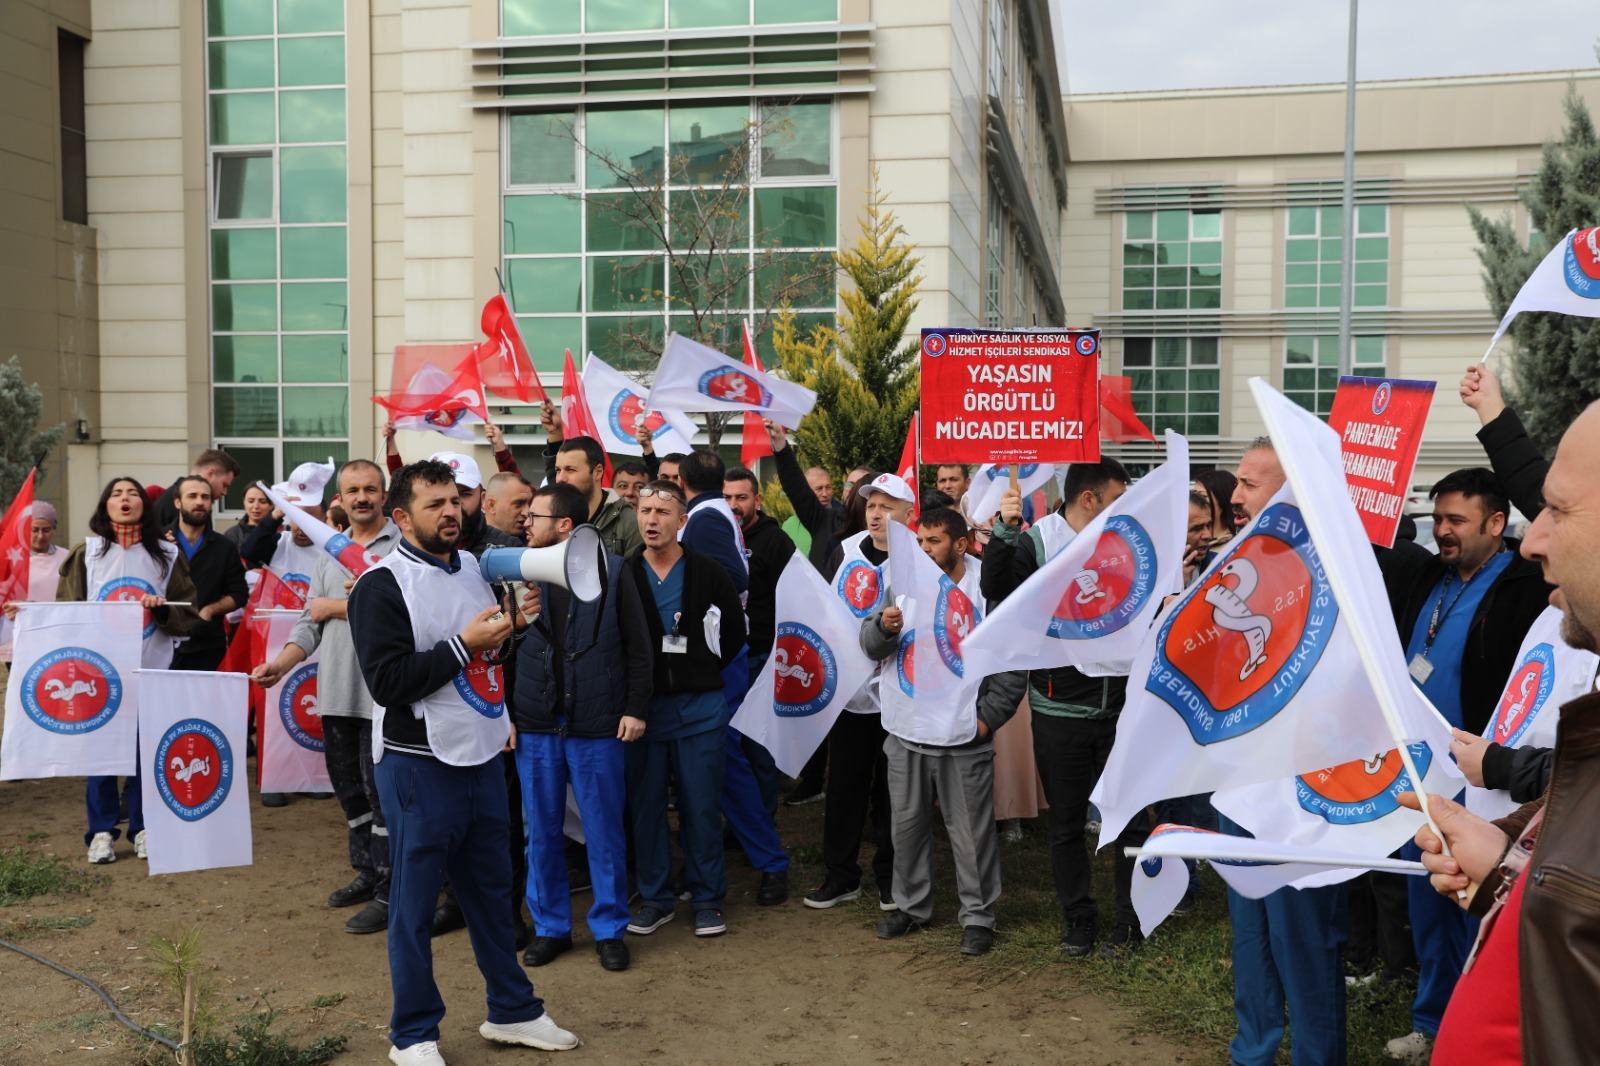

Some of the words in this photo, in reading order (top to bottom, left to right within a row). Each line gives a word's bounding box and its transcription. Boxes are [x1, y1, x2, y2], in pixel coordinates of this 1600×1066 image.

[949, 333, 988, 344] TÜRKİYE
[989, 333, 1021, 343] SAĞLIK
[1024, 335, 1035, 343] VE
[1036, 335, 1071, 343] SOSYAL
[949, 345, 982, 356] HİZMET
[985, 345, 1022, 359] İŞÇİLERİ
[1024, 345, 1070, 356] SENDİKASI
[967, 364, 1052, 387] YAŞASIN
[963, 388, 1055, 411] ÖRGÜTLÜ
[935, 416, 1083, 440] MÜCADELEMİZ!
[1343, 421, 1402, 450] PANDEMİDE
[1342, 451, 1397, 486] HRAMANDIK,
[1347, 484, 1401, 518] UTULDUK!
[463, 686, 488, 710] TÜRKİYE
